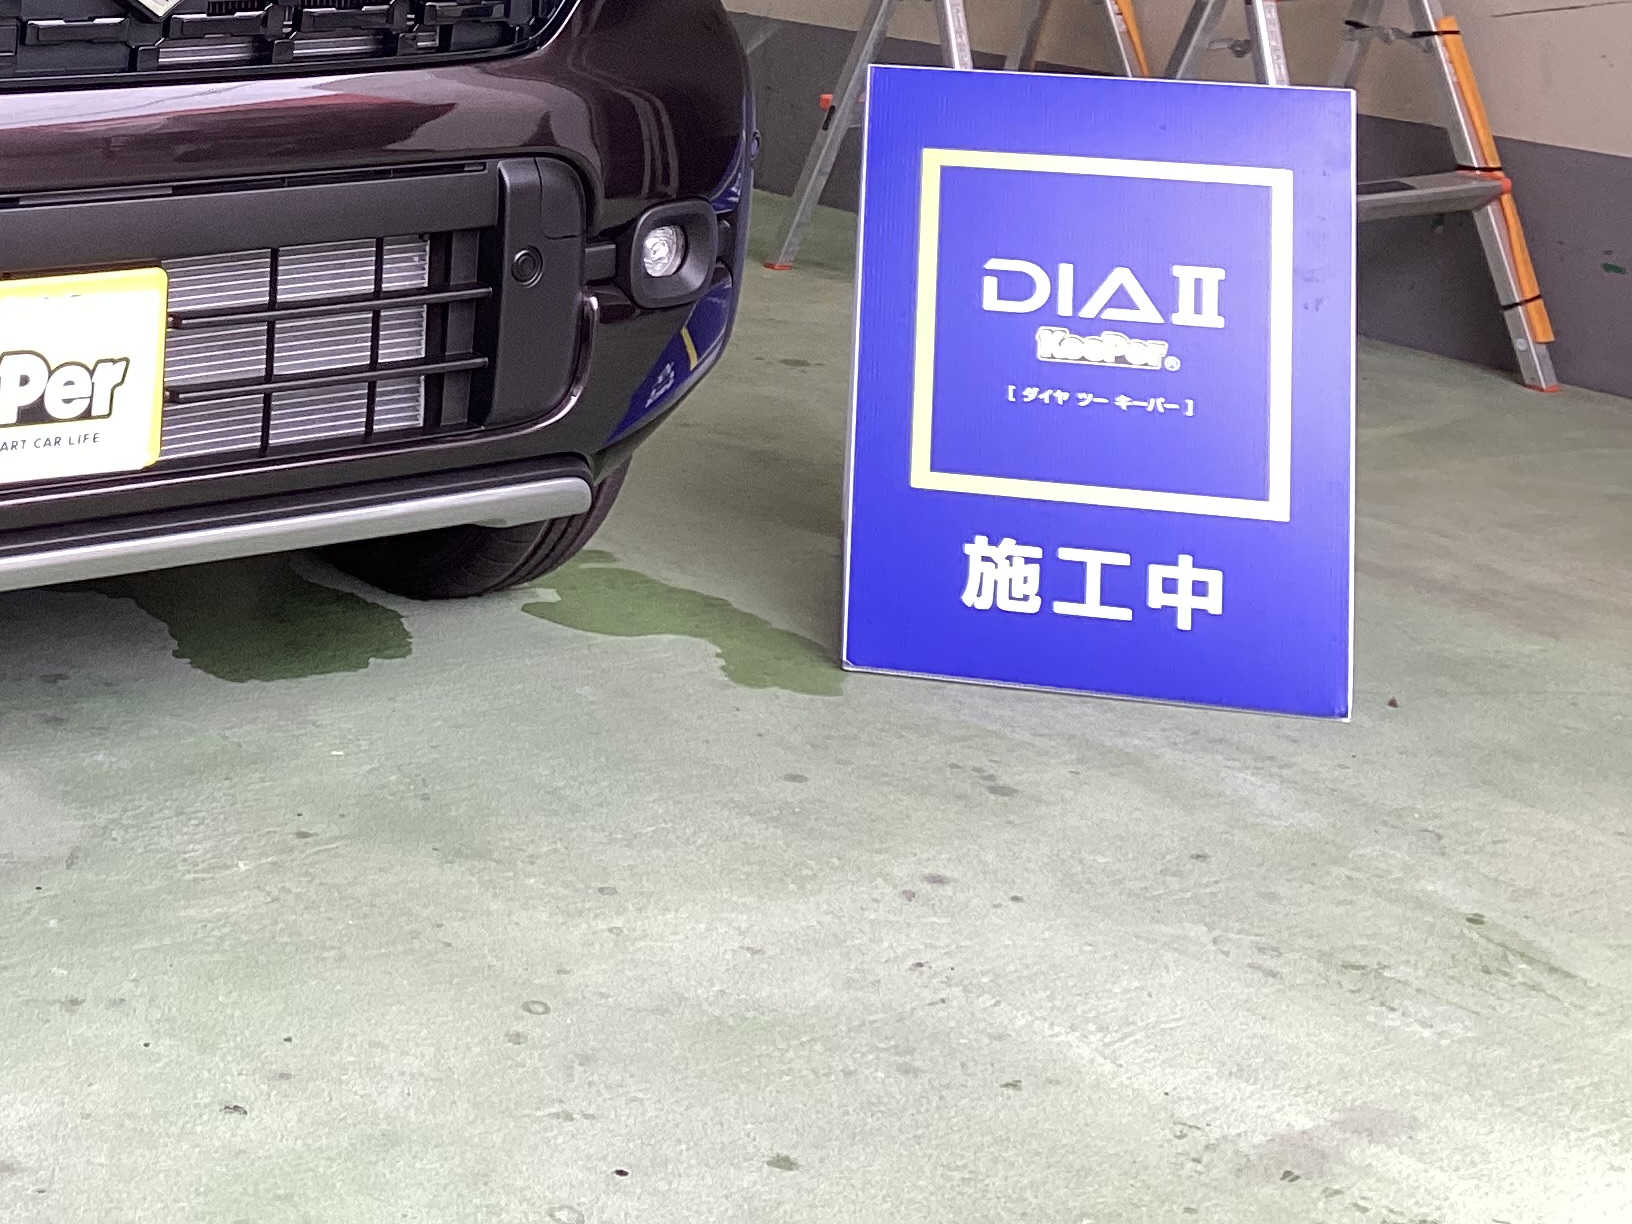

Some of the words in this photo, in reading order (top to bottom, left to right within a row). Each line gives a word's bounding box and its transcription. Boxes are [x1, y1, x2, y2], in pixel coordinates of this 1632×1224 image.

[33, 436, 63, 449] CAR
[68, 432, 101, 446] LIFE
[961, 534, 1224, 631] 施工中
